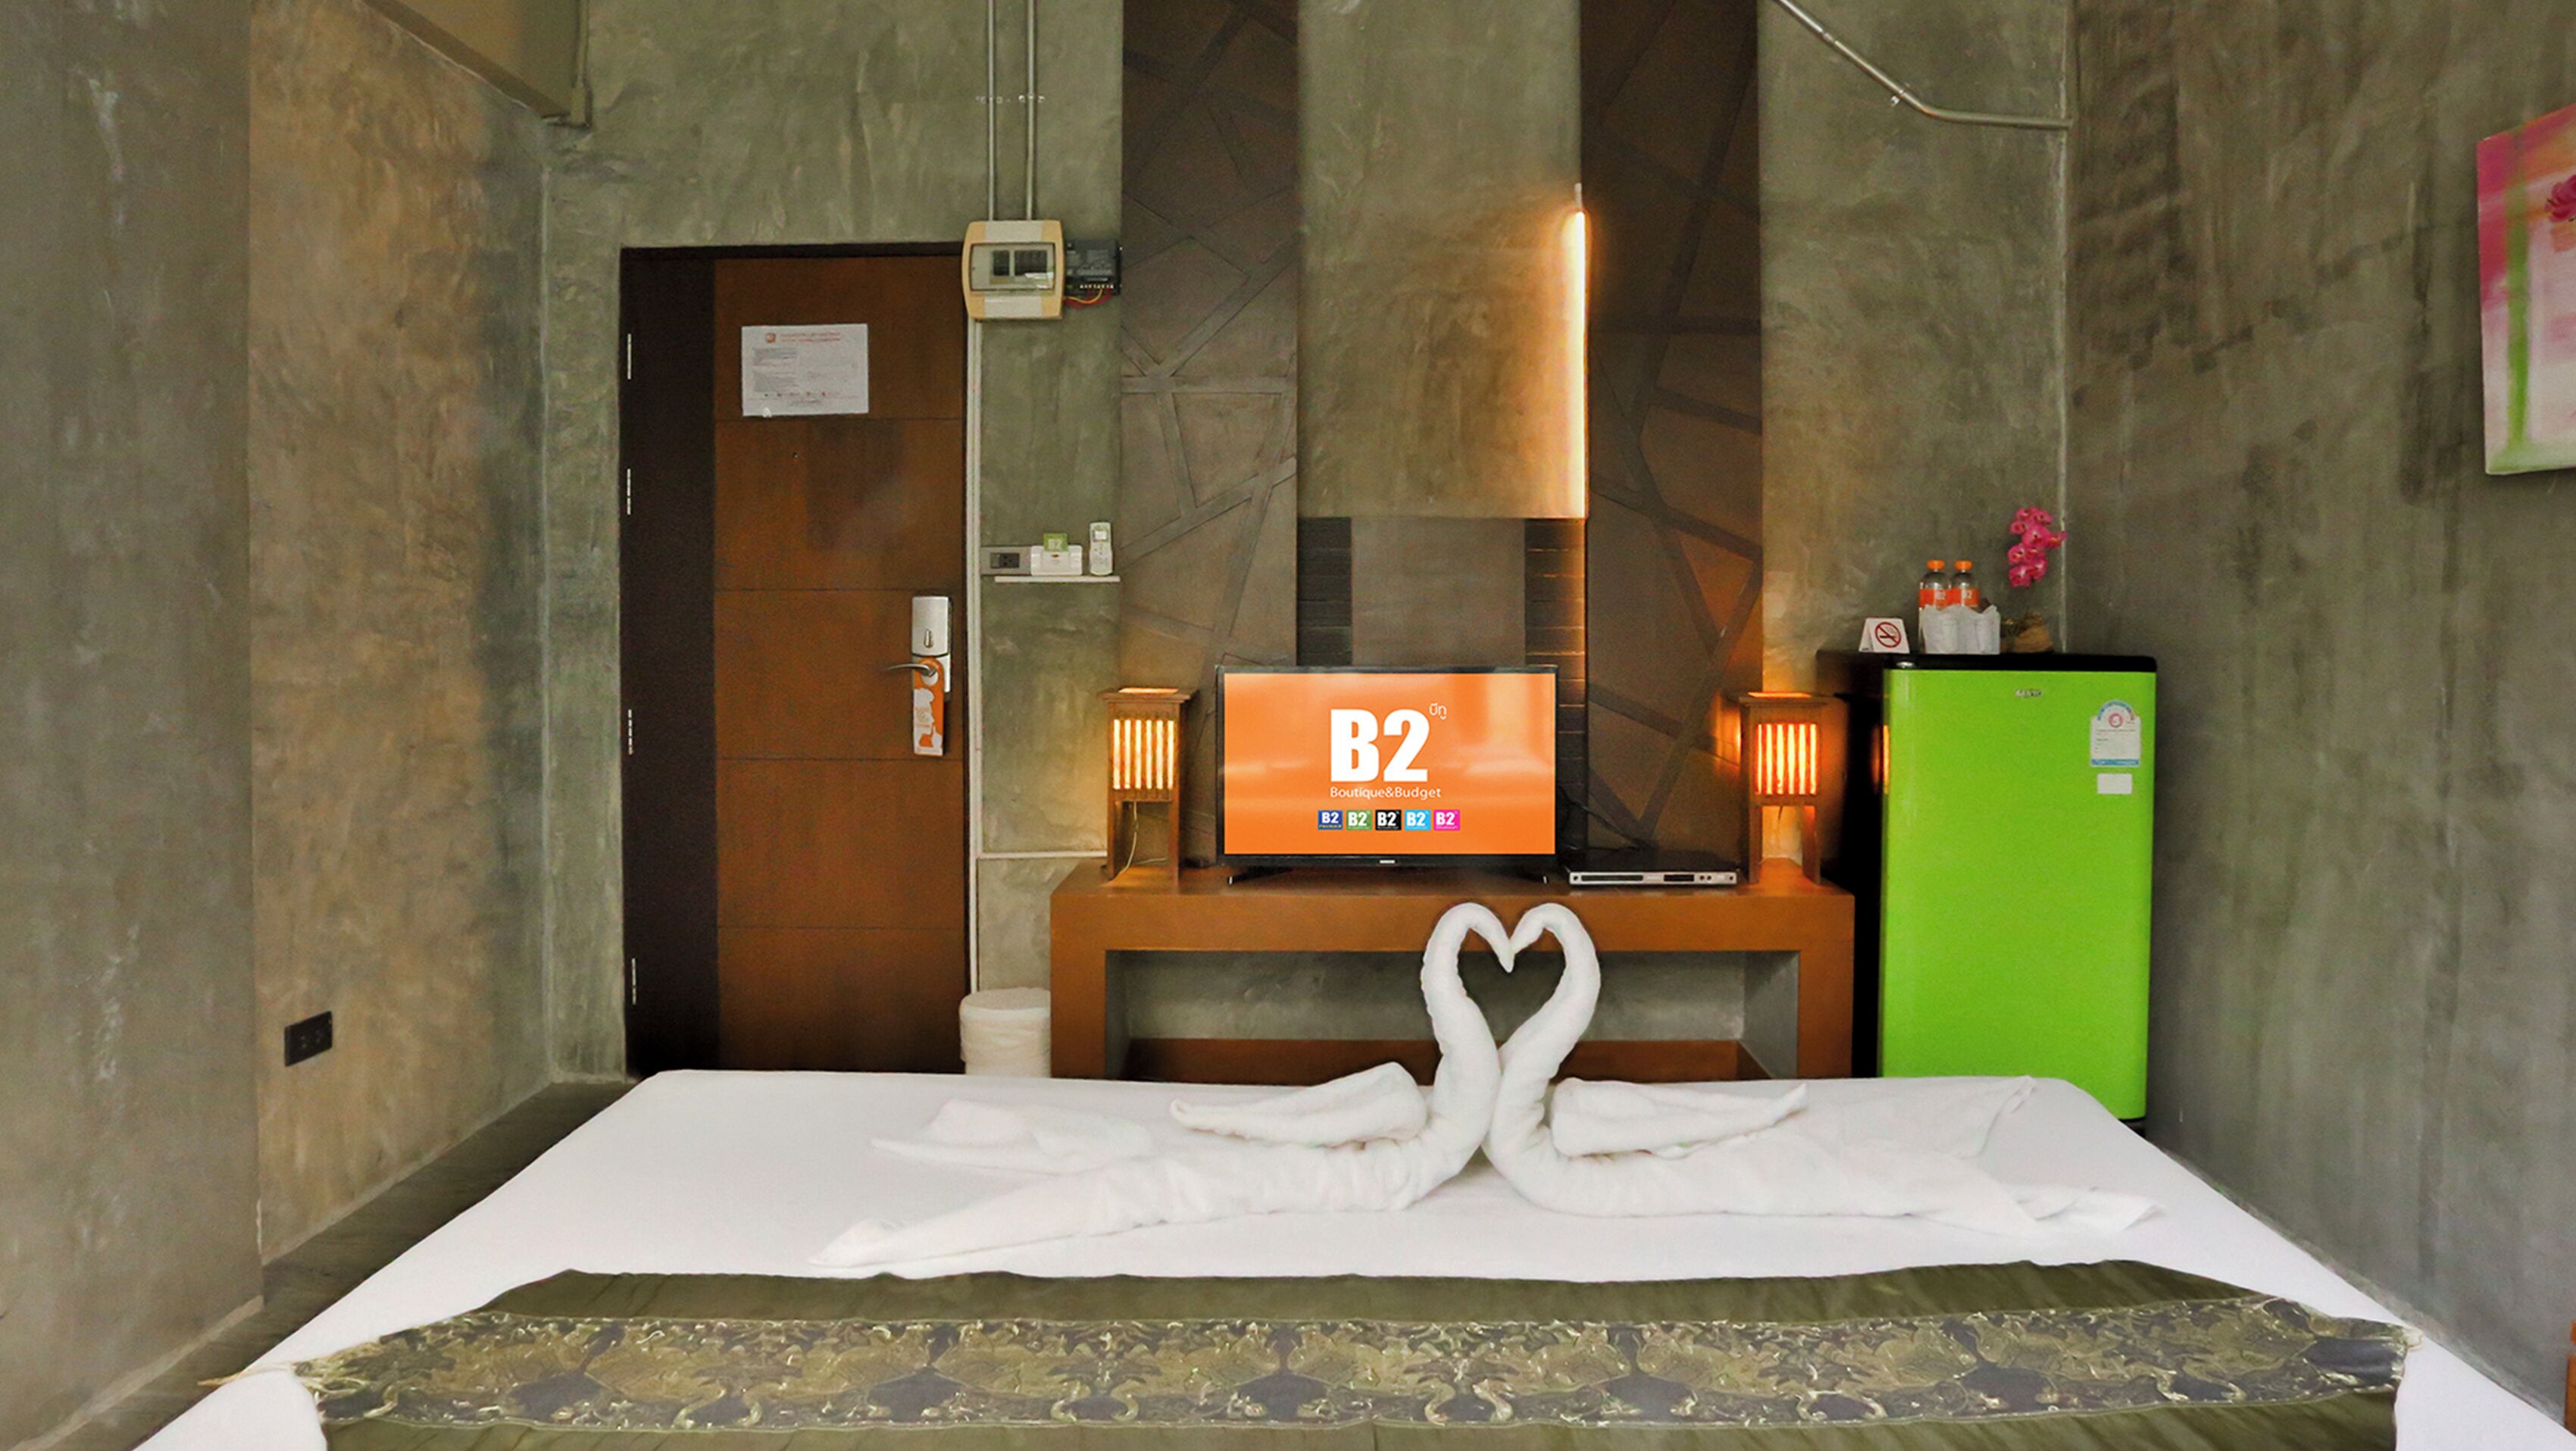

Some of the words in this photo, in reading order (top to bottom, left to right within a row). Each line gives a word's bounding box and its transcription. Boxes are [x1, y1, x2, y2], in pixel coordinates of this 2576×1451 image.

[1330, 709, 1430, 782] B2
[1330, 786, 1441, 800] Boutique&Budget
[1321, 811, 1340, 824] B2
[1348, 811, 1368, 826] B2
[1377, 811, 1396, 826] B2
[1406, 811, 1426, 826] B2
[1436, 811, 1455, 825] B2
